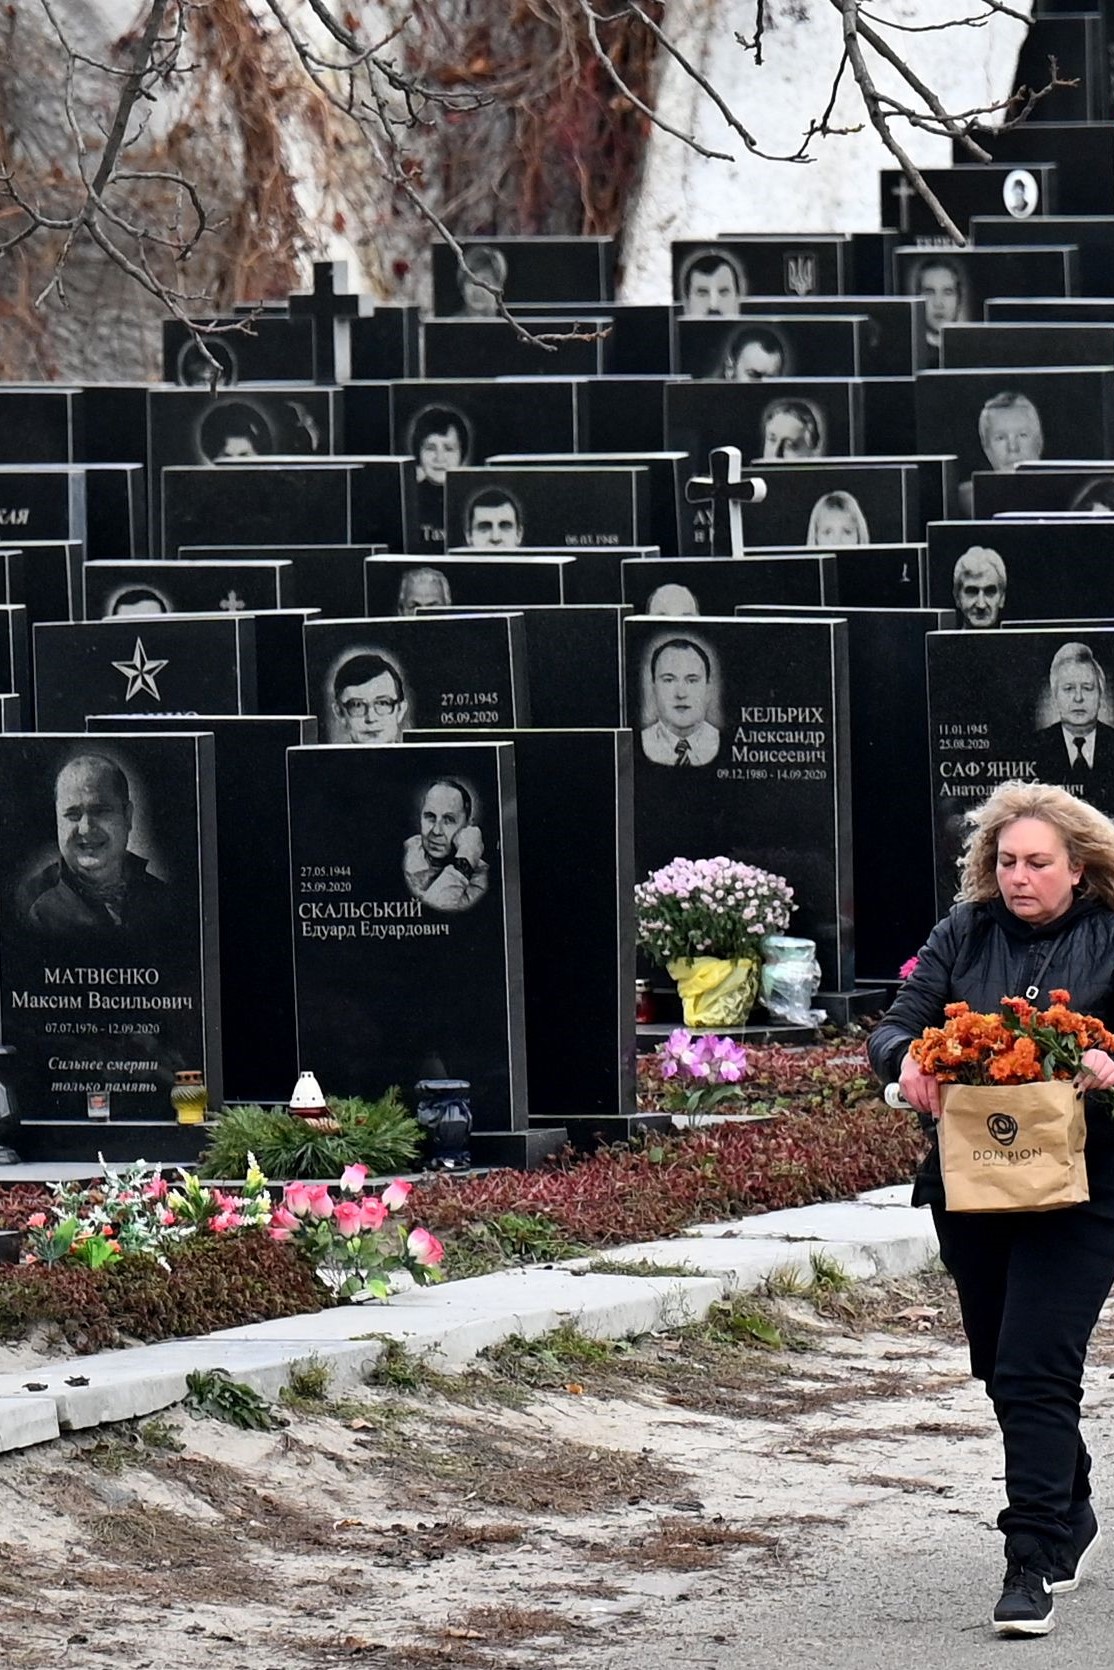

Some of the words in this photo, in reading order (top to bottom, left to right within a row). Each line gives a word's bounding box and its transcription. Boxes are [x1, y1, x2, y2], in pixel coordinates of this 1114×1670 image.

[441, 692, 499, 706] 27.07.1945
[441, 711, 499, 724] 05.09.2020
[741, 707, 824, 723] КЕЛЬРИХ
[939, 724, 988, 735] 11.01.1945
[734, 726, 825, 748] Александр
[939, 739, 990, 750] 25.08.2020
[732, 745, 826, 763] Моисеевич
[777, 769, 827, 780] 14.09.2020
[300, 866, 351, 878] 27.05.1944
[300, 881, 352, 893] 25.09.2020
[298, 897, 422, 919] СКАЛЬСЬКИЙ
[302, 921, 356, 940] Едуард
[360, 921, 450, 940] Едуардович
[44, 968, 160, 985] МАТВІЄНКО
[12, 991, 82, 1009] Максим
[88, 991, 193, 1010] Васильович
[45, 1023, 98, 1034] 07.07.1976
[107, 1023, 160, 1035] 12.09.2020
[48, 1056, 104, 1071] Сильнее
[106, 1060, 158, 1074] смерти
[51, 1081, 100, 1093] только
[104, 1081, 158, 1093] память
